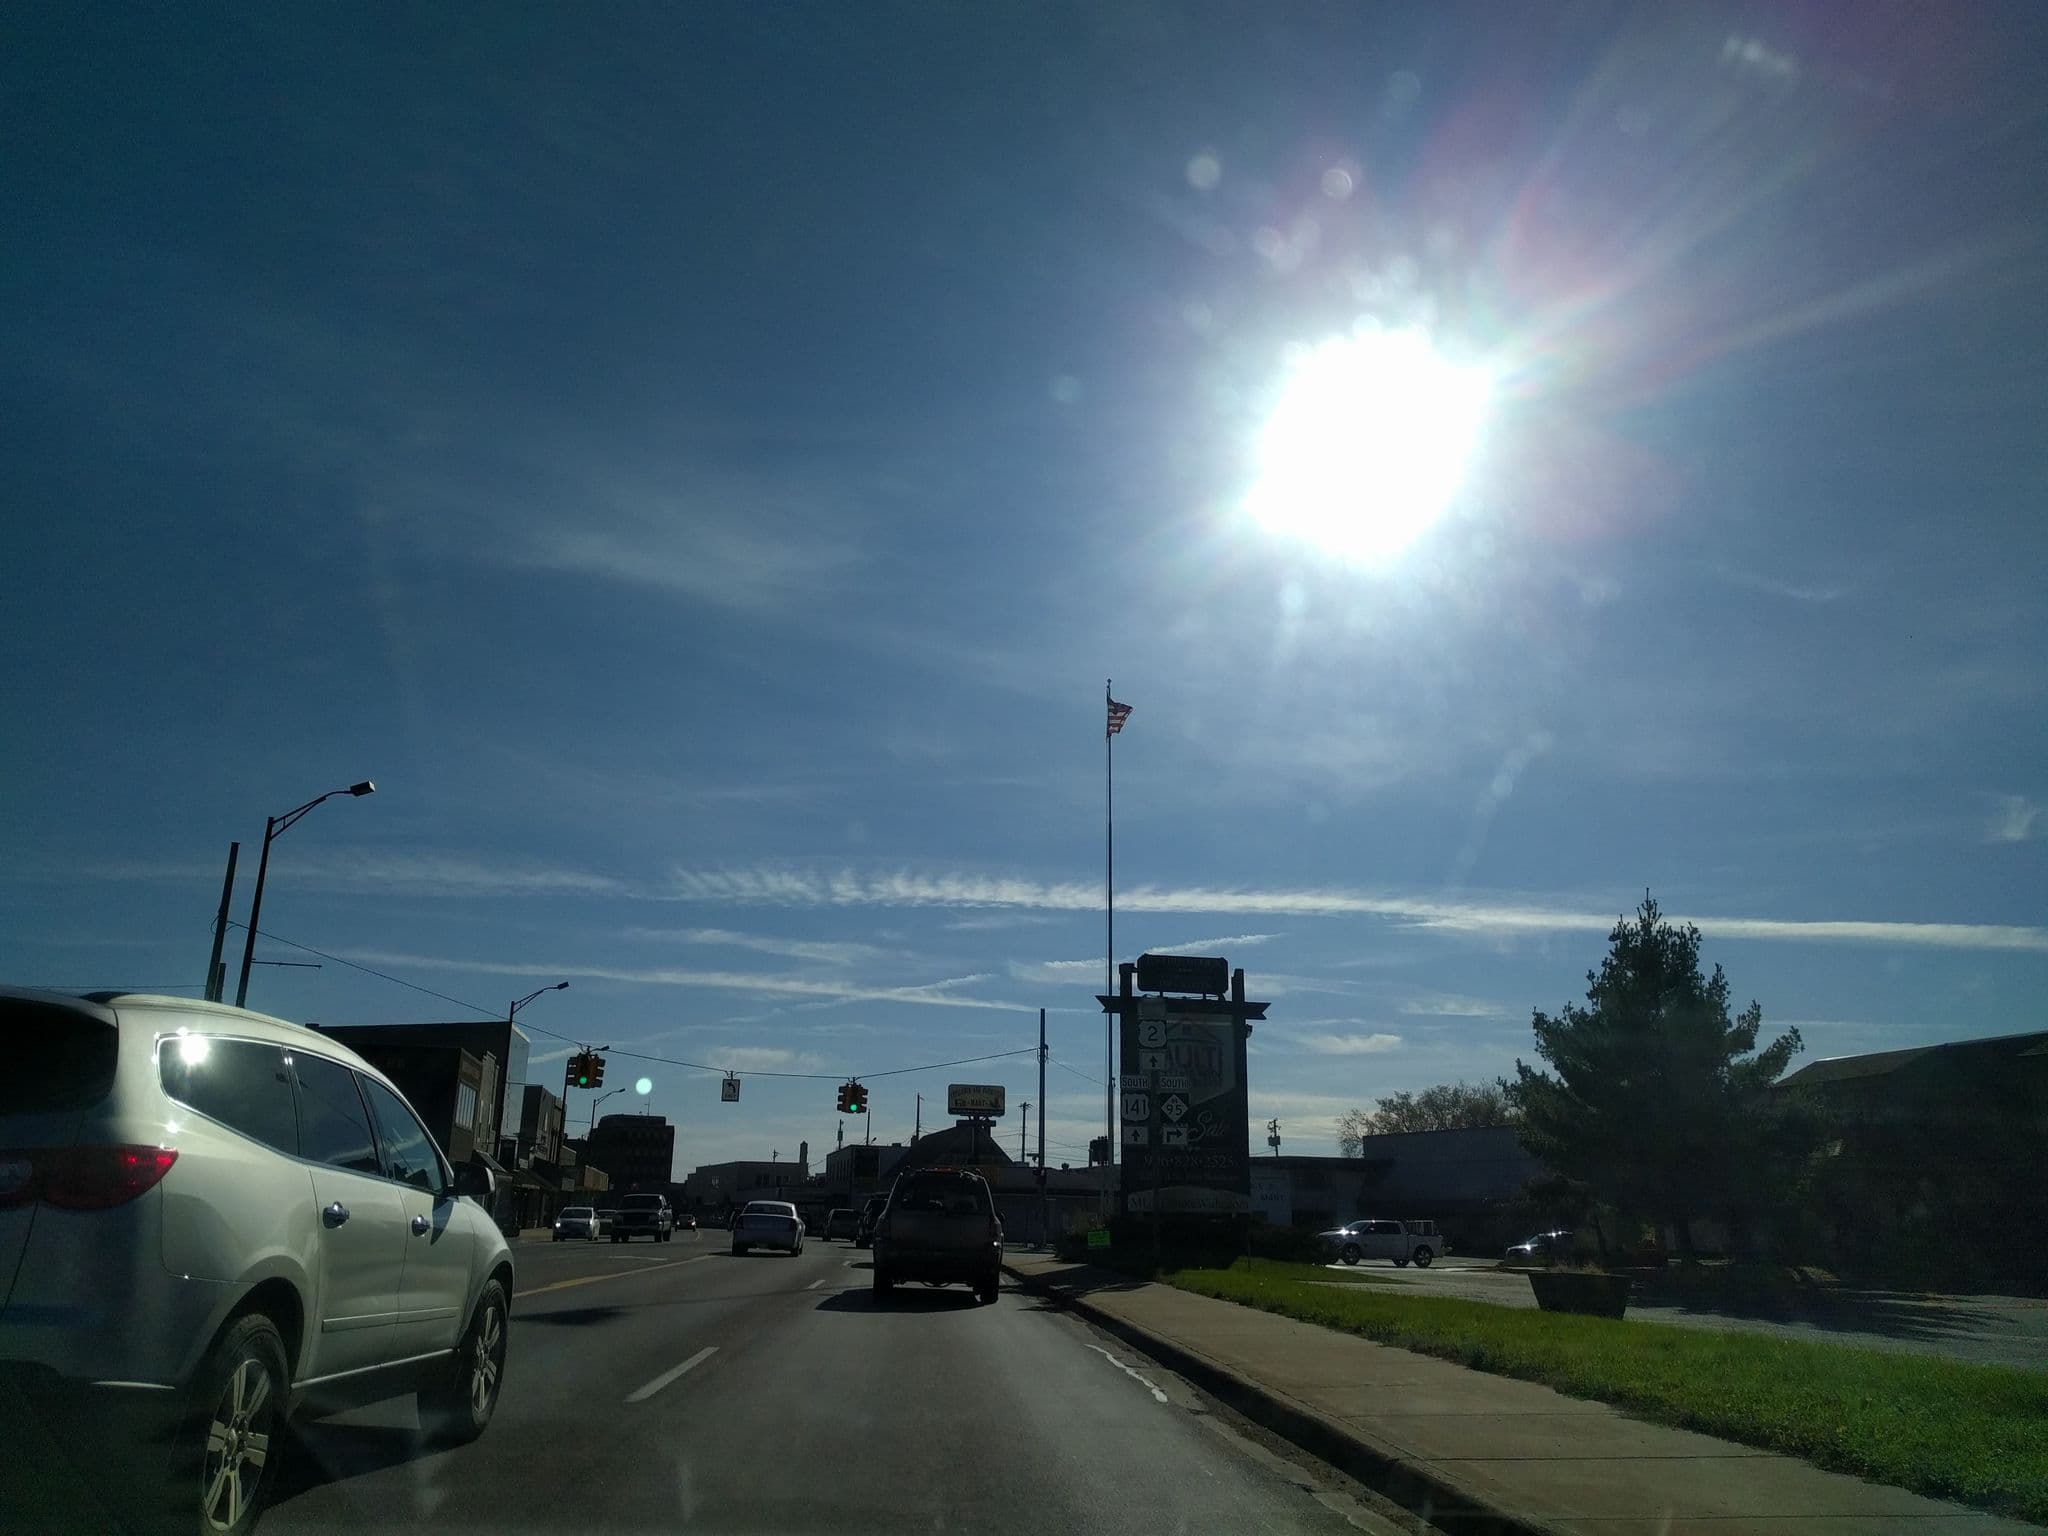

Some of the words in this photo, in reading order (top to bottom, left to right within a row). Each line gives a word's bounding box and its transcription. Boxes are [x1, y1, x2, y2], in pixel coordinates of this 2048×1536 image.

[1147, 1026, 1158, 1041] 2
[1122, 1078, 1148, 1087] SOUTH
[1161, 1078, 1188, 1087] SOUTH
[1124, 1098, 1147, 1115] 141
[1166, 1104, 1183, 1116] 95
